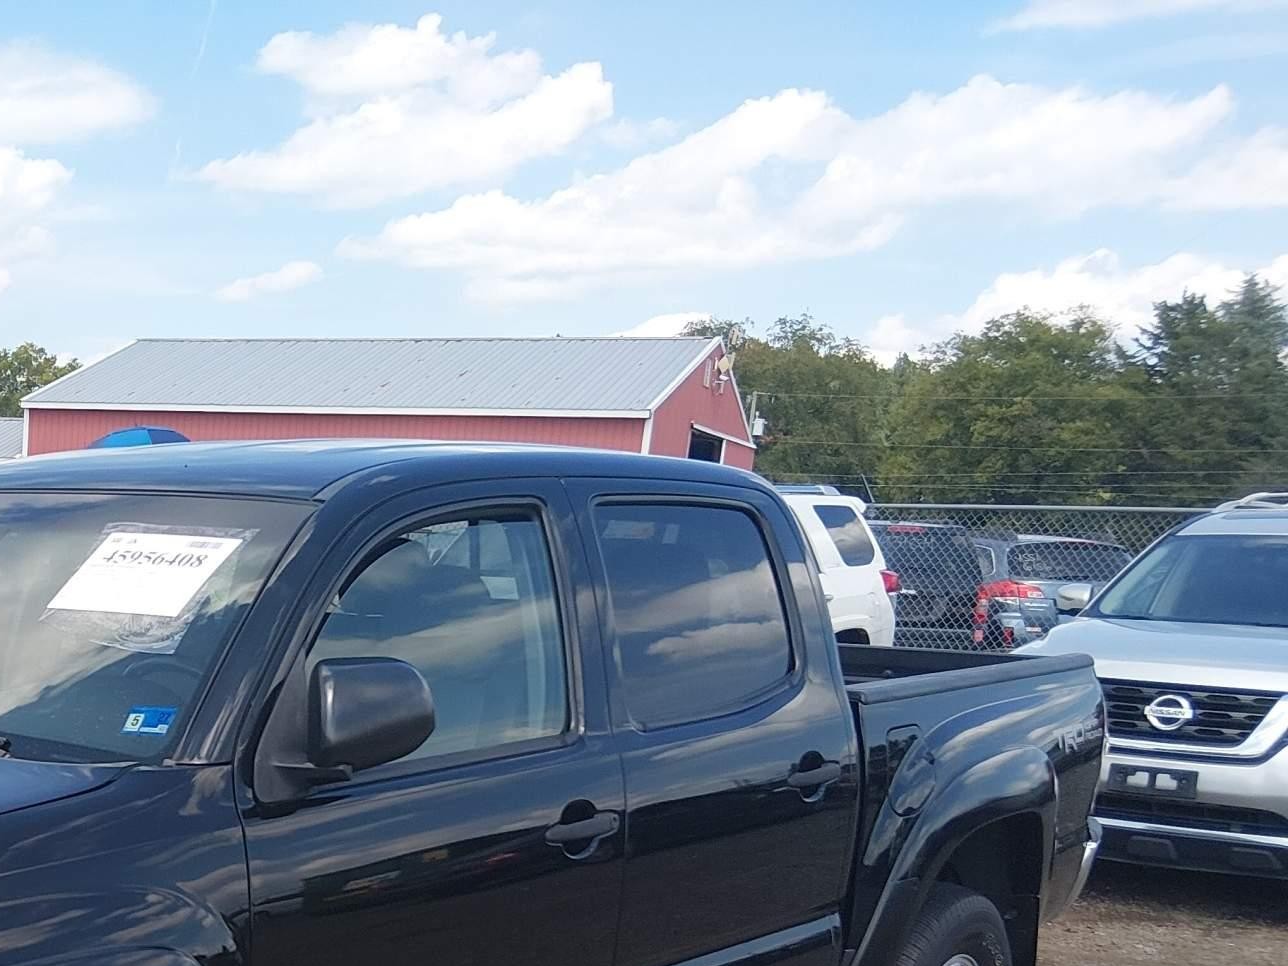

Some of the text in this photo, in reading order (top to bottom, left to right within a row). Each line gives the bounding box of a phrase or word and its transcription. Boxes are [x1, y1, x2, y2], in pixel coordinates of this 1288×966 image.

[103, 550, 209, 568] 45956408
[1147, 706, 1188, 717] NISSAN
[130, 714, 142, 727] 5
